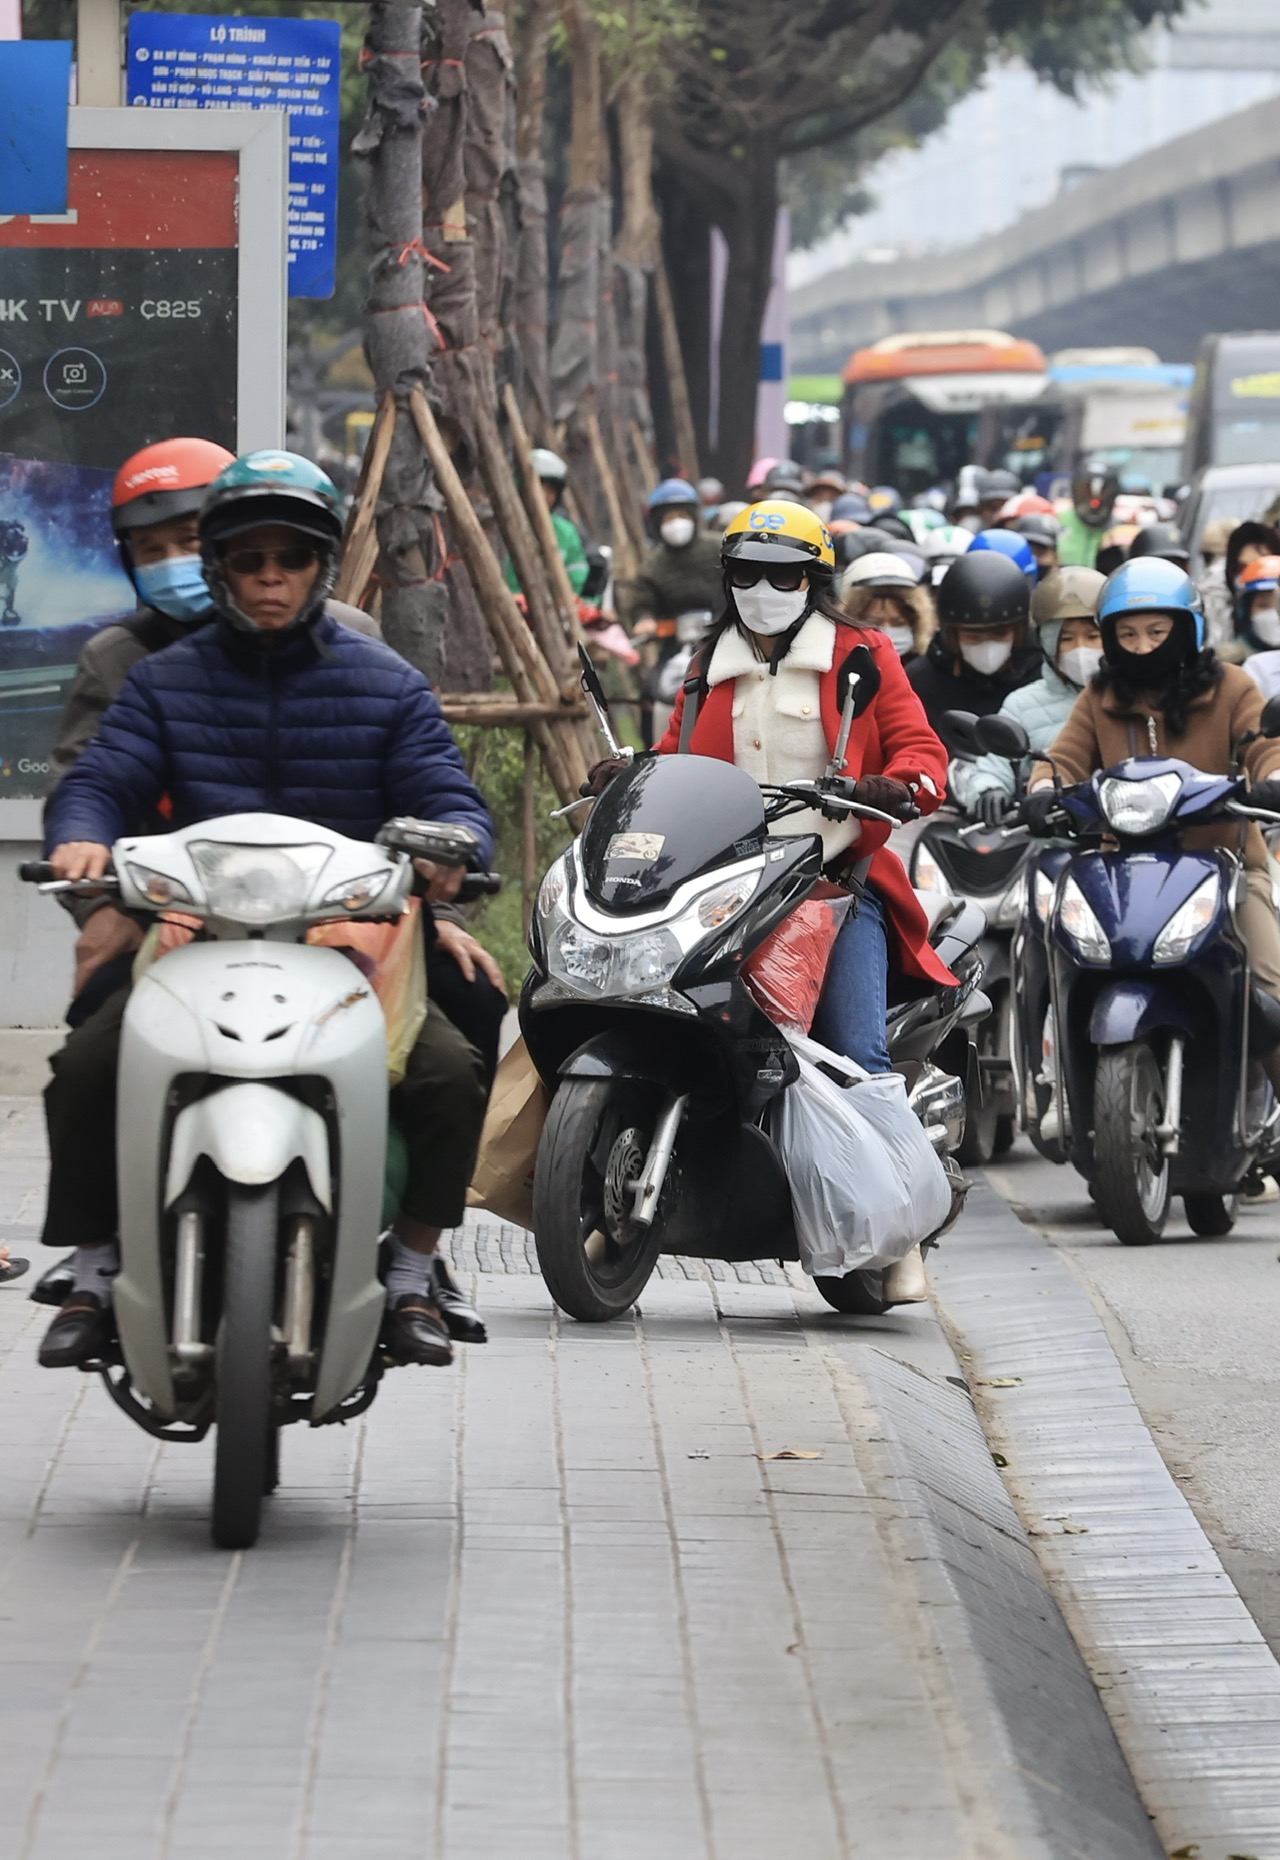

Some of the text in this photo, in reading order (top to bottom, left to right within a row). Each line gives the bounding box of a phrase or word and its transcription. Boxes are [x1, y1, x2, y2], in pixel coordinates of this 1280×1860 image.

[210, 24, 266, 44] LỘ TRÌNH
[39, 299, 81, 321] TV
[140, 300, 201, 318] C825
[749, 511, 787, 531] be
[604, 876, 643, 888] HONDA
